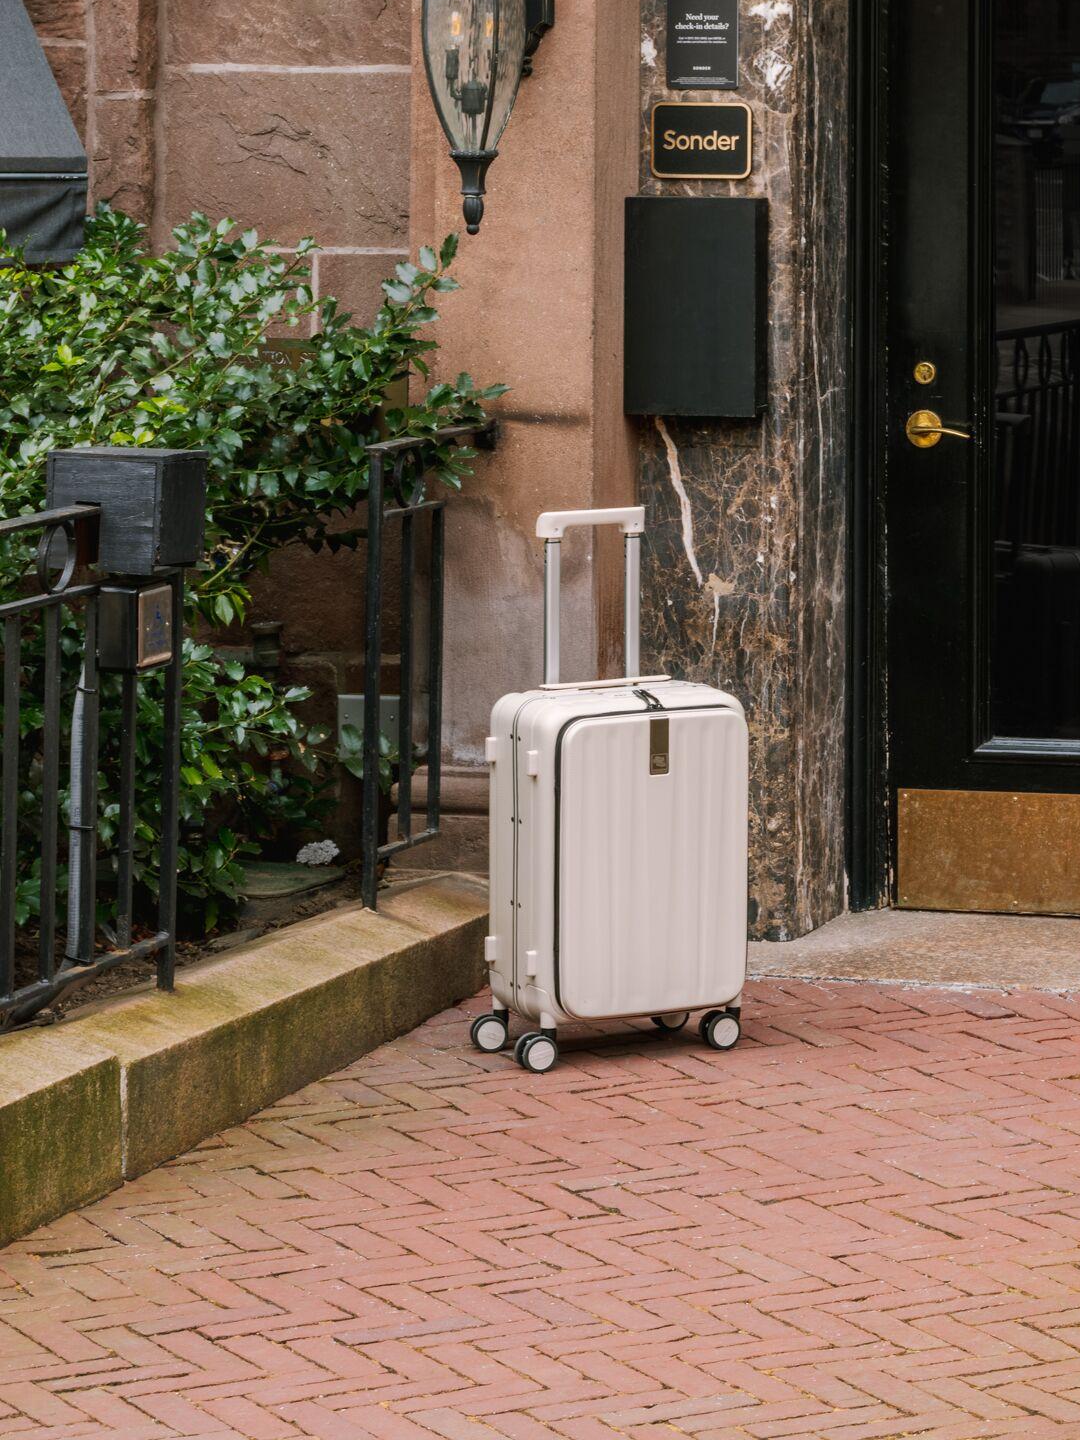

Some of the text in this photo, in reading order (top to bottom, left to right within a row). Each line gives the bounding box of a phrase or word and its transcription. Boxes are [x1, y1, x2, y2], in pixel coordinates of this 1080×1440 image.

[685, 13, 720, 23] Need your
[674, 22, 730, 30] check-in details?
[662, 129, 740, 151] Sonder
